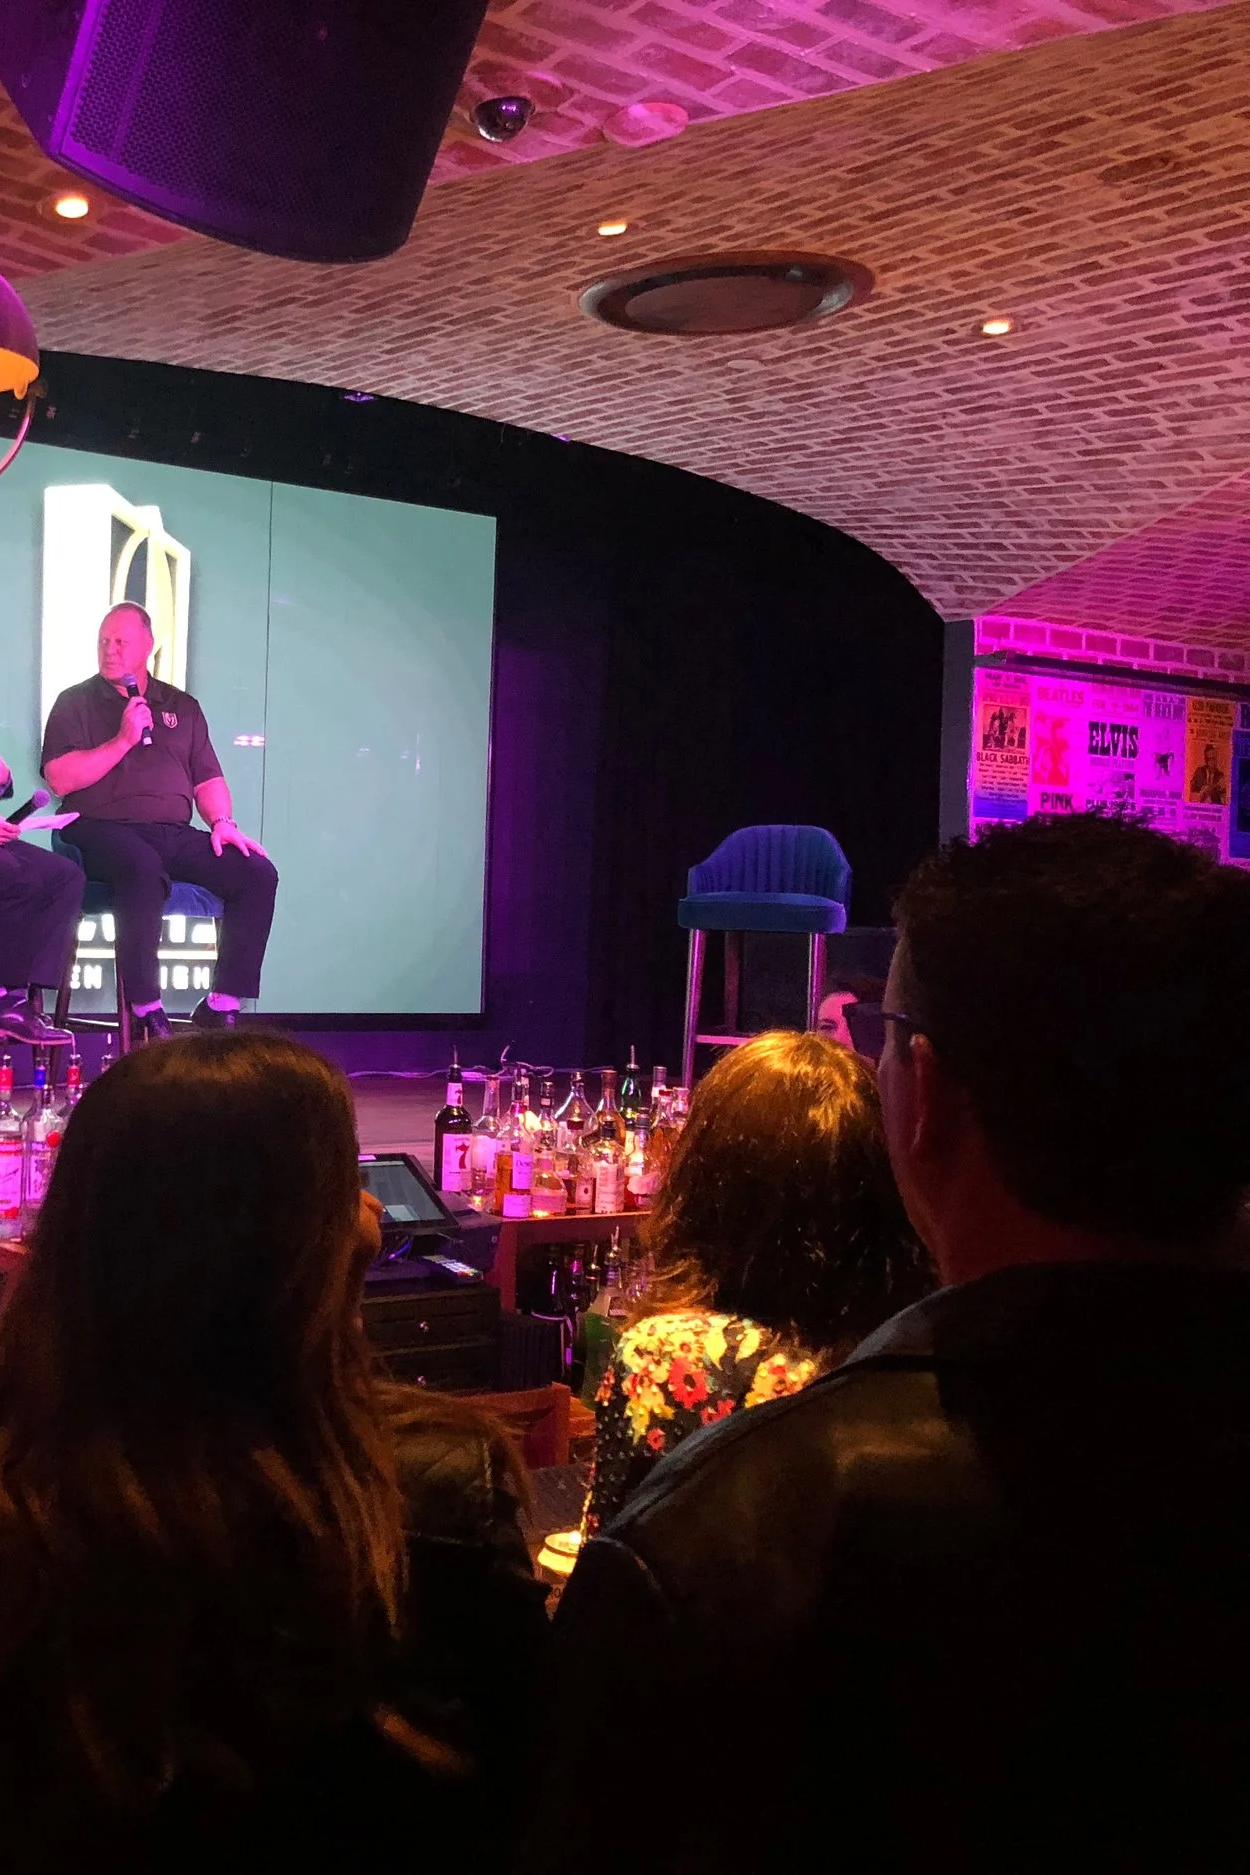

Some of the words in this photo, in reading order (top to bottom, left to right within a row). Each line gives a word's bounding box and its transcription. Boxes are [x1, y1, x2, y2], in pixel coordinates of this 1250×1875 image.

[1036, 685, 1085, 706] BEATLES
[1088, 720, 1139, 760] ELVIS
[976, 752, 998, 764] BLACK
[1040, 791, 1075, 811] PINK
